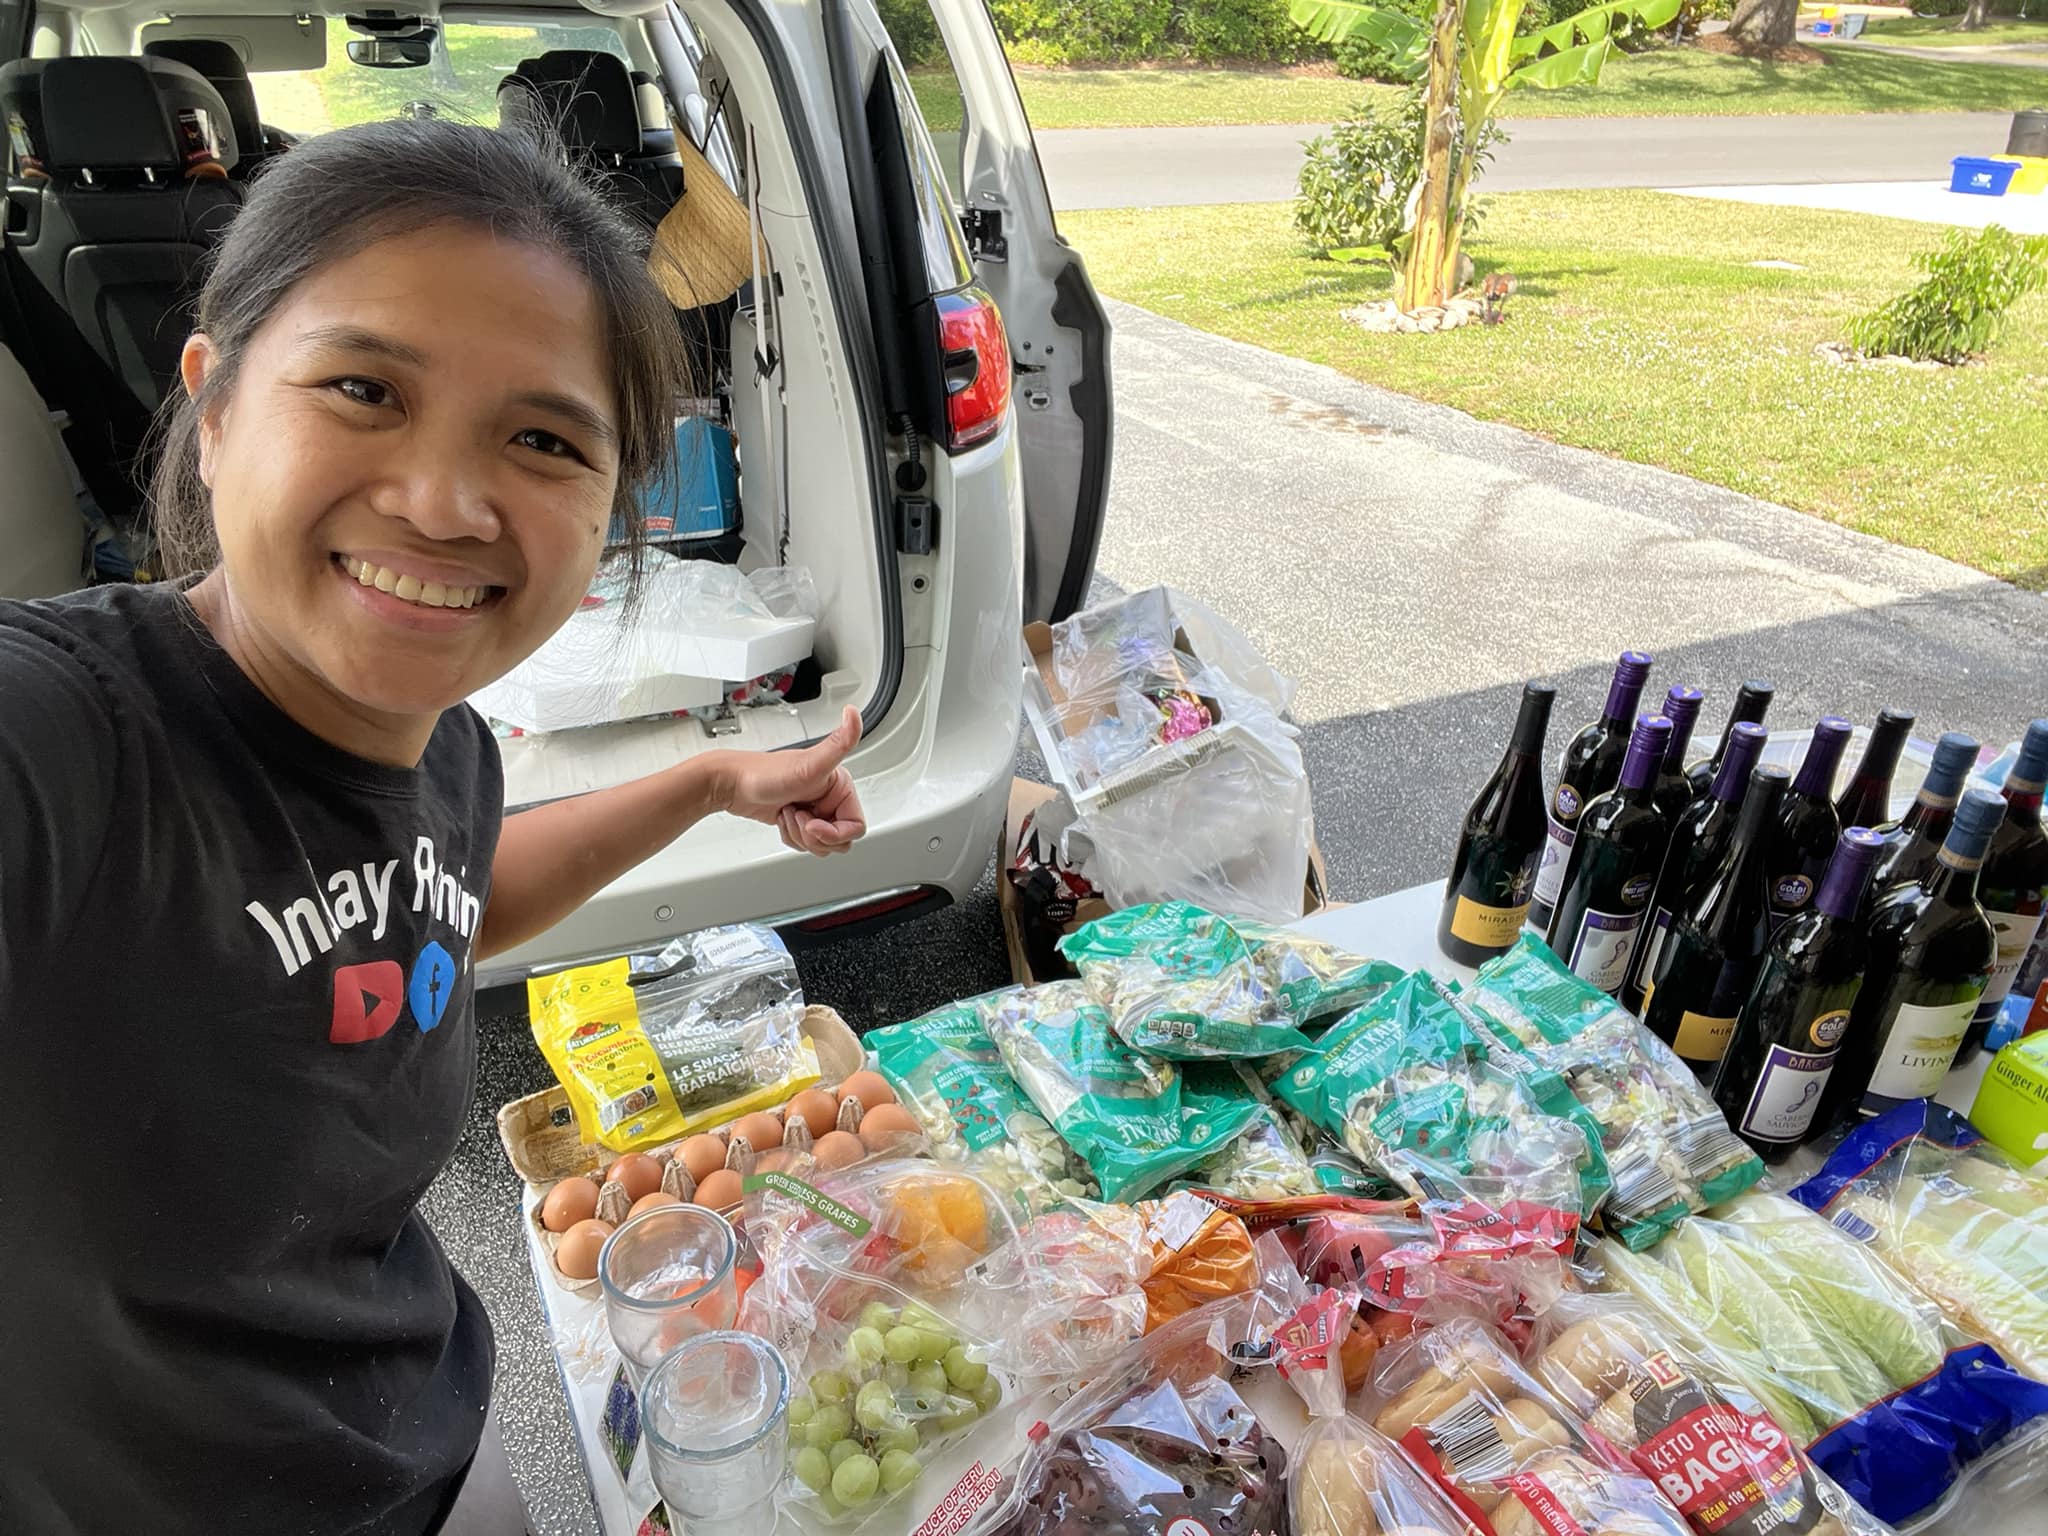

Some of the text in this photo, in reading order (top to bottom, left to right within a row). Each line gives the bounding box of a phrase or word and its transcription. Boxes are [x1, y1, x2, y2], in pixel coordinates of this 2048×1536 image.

[246, 859, 400, 977] Inlay
[1160, 902, 1183, 925] KAL
[685, 1021, 723, 1039] COOL
[672, 1050, 743, 1083] LE SNACK
[1325, 1039, 1369, 1075] SWEET
[1901, 1055, 1953, 1067] LIVIN
[1996, 1060, 2034, 1091] Ginger
[765, 1173, 859, 1230] GREEN SEEDLESS GRAPES
[1648, 1432, 1693, 1472] KETO
[944, 1488, 960, 1513] OF
[957, 1460, 985, 1497] PERU
[947, 1468, 1003, 1535] DES PÉROU
[1515, 1474, 1539, 1500] KETO
[1700, 1500, 1729, 1525] VEGAN
[1752, 1505, 1785, 1536] ZERO
